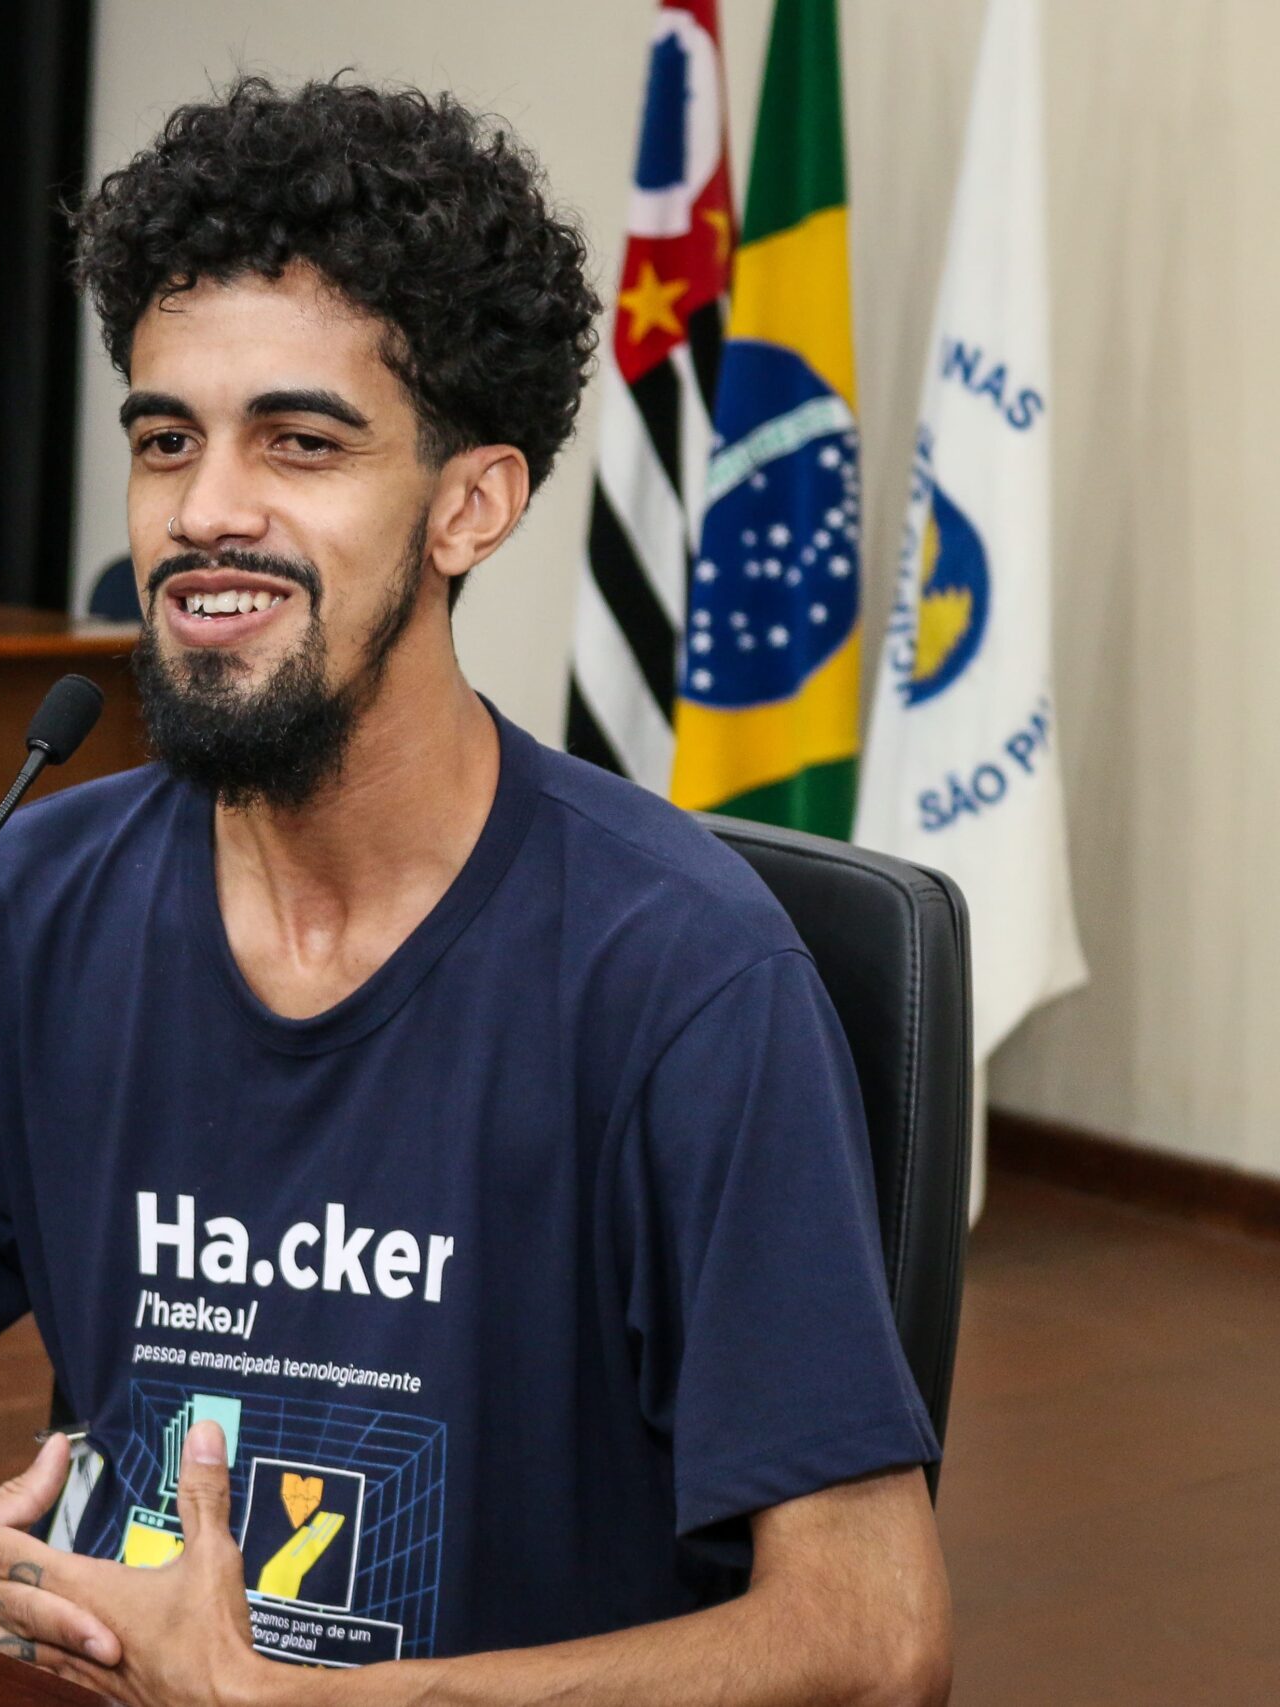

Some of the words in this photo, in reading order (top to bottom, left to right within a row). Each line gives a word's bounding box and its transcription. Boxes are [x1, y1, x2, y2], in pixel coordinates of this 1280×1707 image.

[136, 1191, 454, 1302] Ha.cker
[133, 1343, 186, 1363] pessoa
[189, 1351, 280, 1376] emancipada
[283, 1357, 421, 1393] tecnologicamente
[249, 1608, 289, 1629] azemos
[292, 1620, 324, 1636] parte
[327, 1625, 345, 1639] de
[350, 1629, 371, 1642] um
[280, 1633, 317, 1652] global
